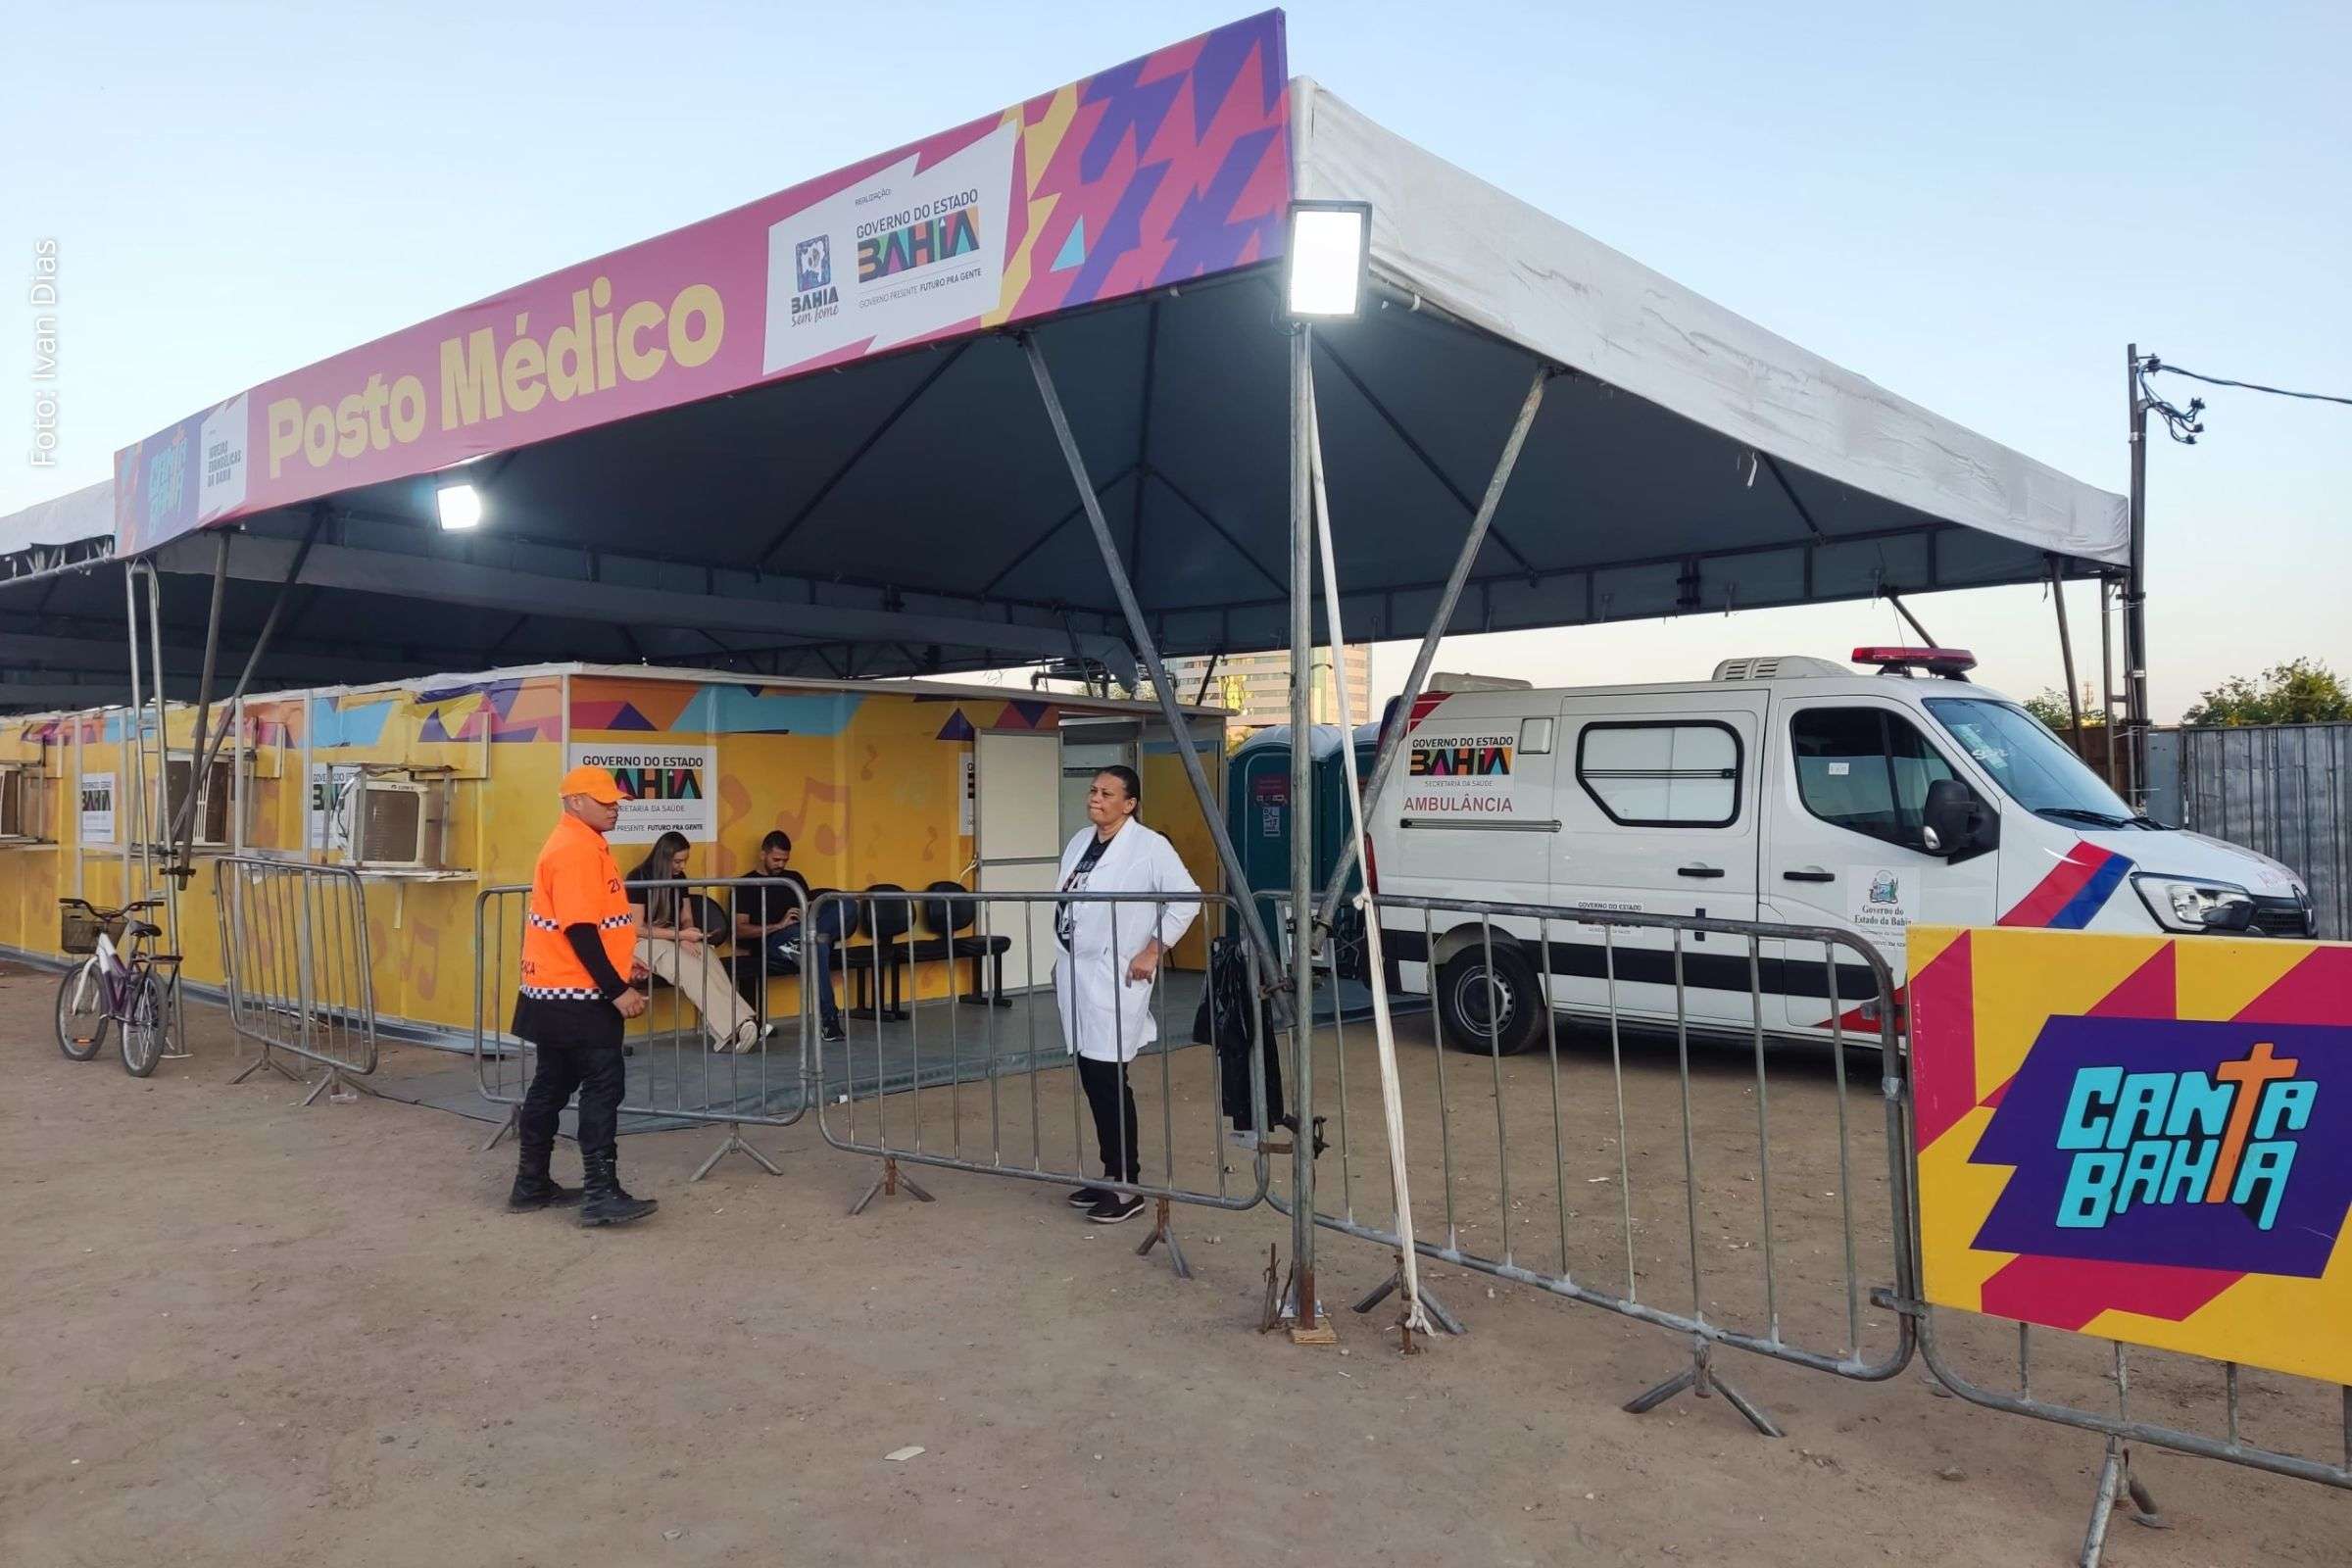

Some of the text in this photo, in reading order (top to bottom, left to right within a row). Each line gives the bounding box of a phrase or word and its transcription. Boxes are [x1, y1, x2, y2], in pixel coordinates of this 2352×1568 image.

[856, 188, 978, 239] GOVERNO DO ESTADO
[857, 207, 980, 284] BAHIA
[890, 285, 918, 301] PRESENTE
[919, 277, 946, 293] FUTURO
[946, 275, 959, 285] PRA
[959, 268, 982, 282] GENTE
[791, 286, 839, 315] BAHIA
[791, 304, 840, 328] sem fome
[267, 373, 427, 479] Posto
[439, 275, 725, 432] Médico
[1412, 735, 1514, 749] GOVERNO DO ESTADO
[582, 755, 704, 767] GOVERNO DO ESTADO
[1409, 747, 1513, 776] BAHIA
[612, 767, 704, 800] AHIA
[651, 804, 661, 813] DA
[662, 801, 685, 813] SAÚDE
[1403, 793, 1513, 812] AMBULÂNCIA
[1854, 914, 1879, 924] Estado
[1880, 916, 1889, 925] da
[1861, 904, 1905, 915] Governo do
[2055, 1042, 2319, 1151] CANTA
[2055, 1138, 2298, 1231] BAHIA
